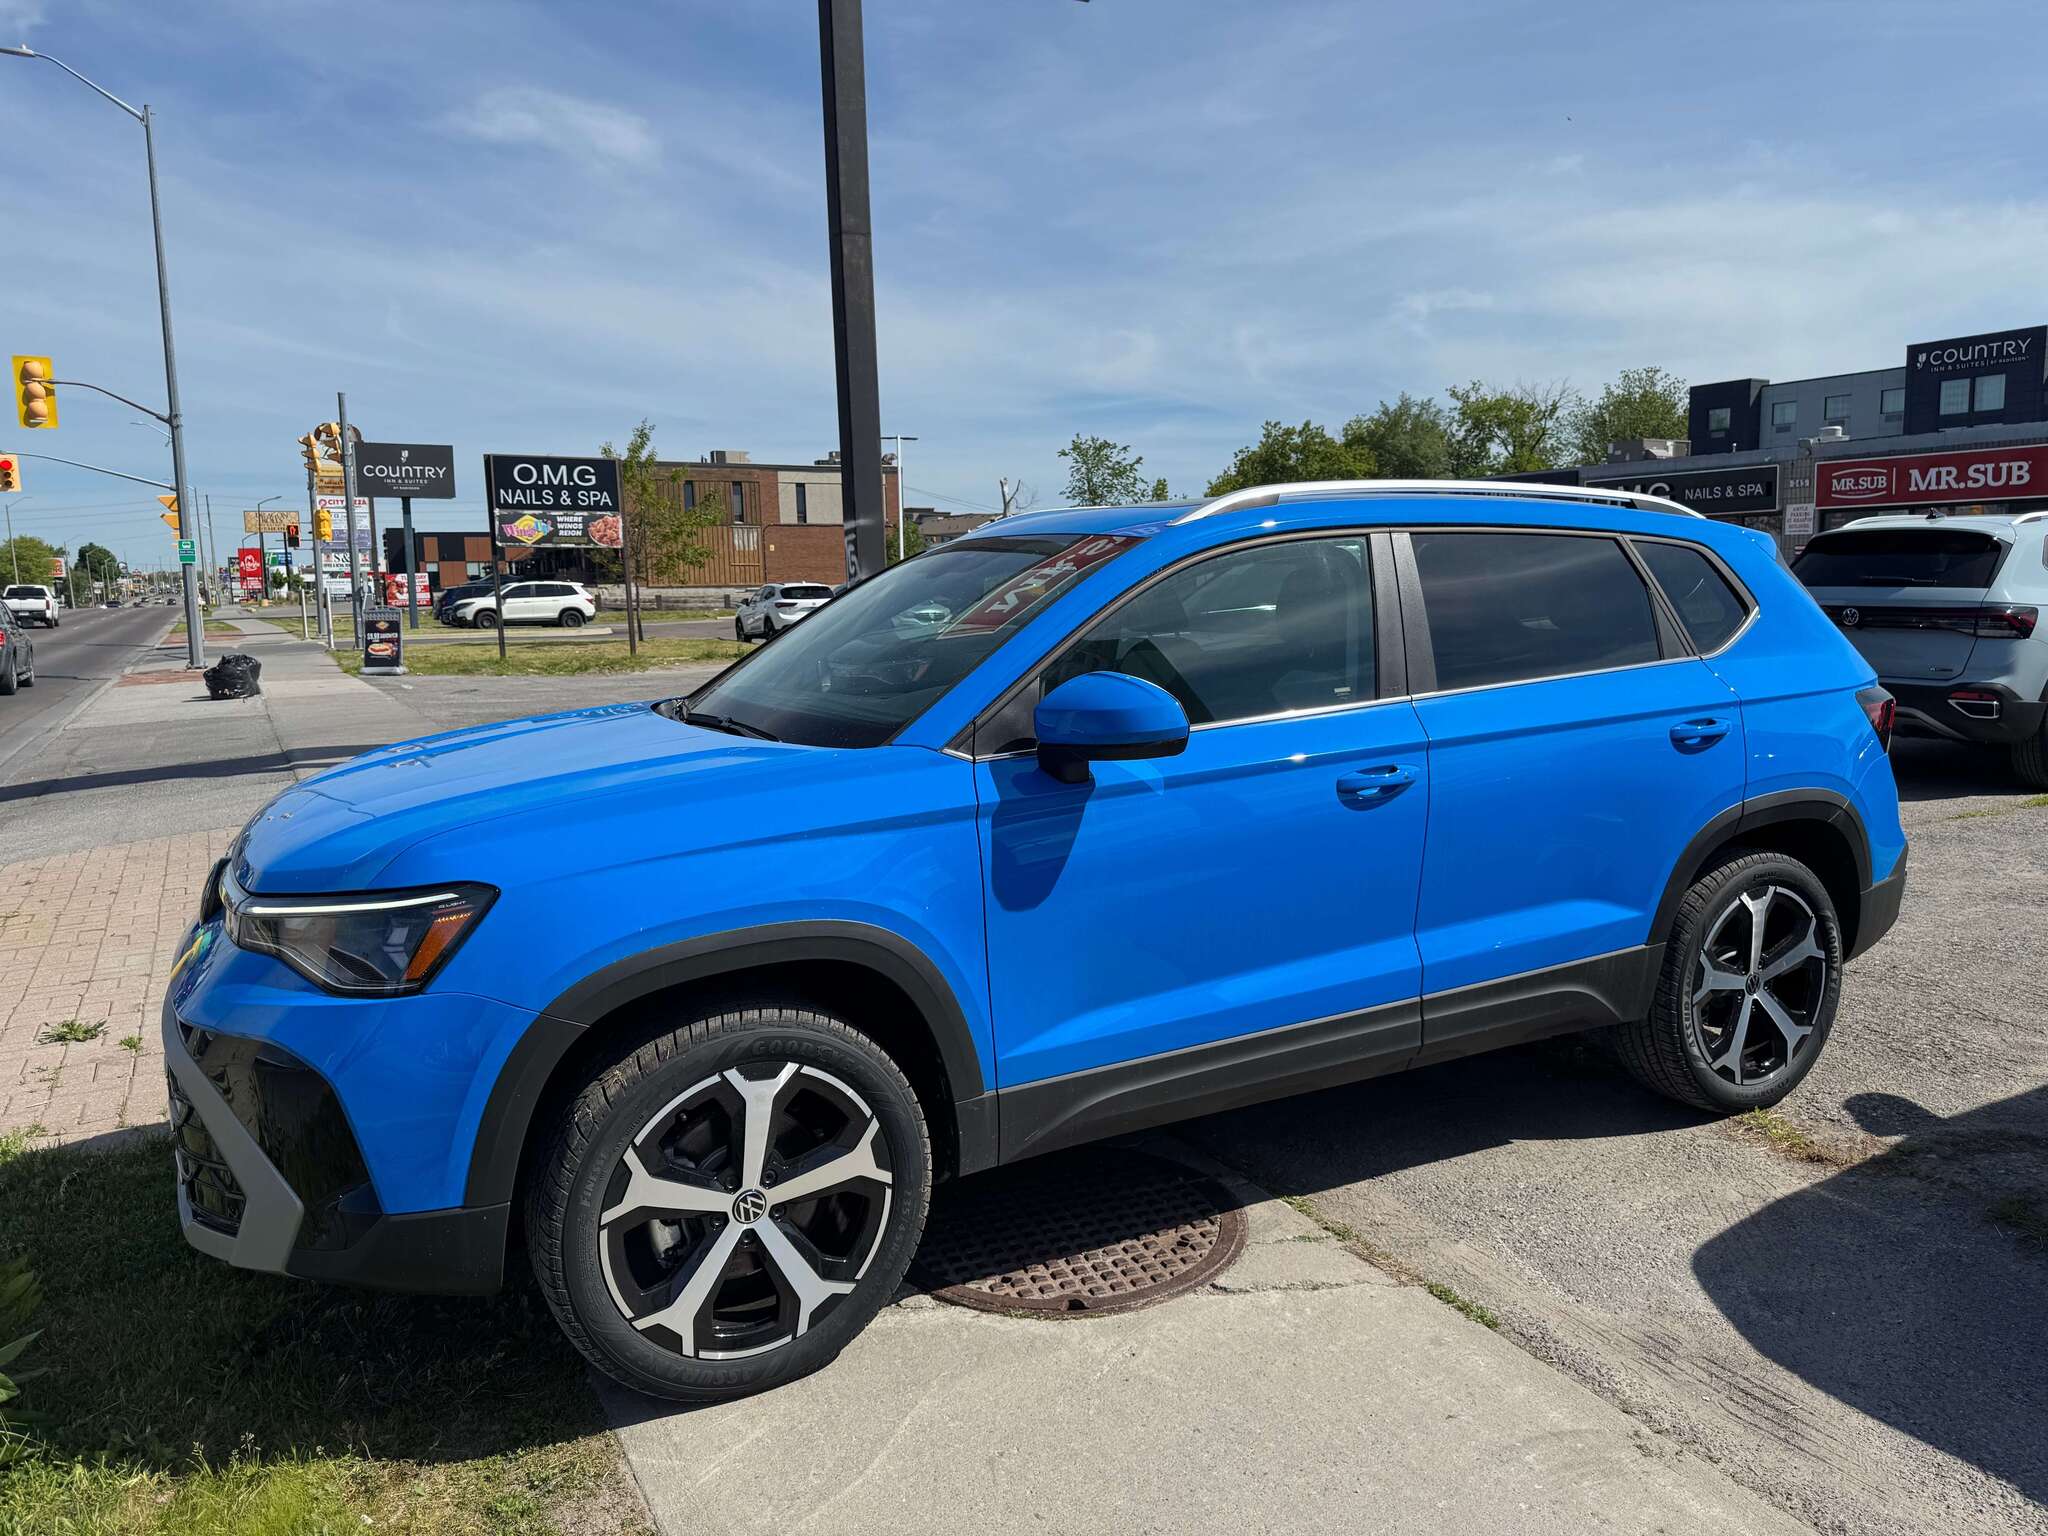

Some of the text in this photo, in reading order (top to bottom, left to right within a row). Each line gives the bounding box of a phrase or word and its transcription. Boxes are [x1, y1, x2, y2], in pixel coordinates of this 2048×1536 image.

[1930, 337, 2031, 365] COUNTRY
[1956, 361, 1985, 369] SUITES
[363, 464, 446, 478] COUNTRY
[513, 463, 596, 486] O.M.G
[1909, 461, 2031, 492] MR.SUB
[1832, 476, 1887, 491] MR.SUB
[500, 489, 612, 506] NAILS & SPA
[1684, 486, 1721, 500] NAILS
[1725, 485, 1734, 497] &
[1737, 484, 1764, 497] SPA
